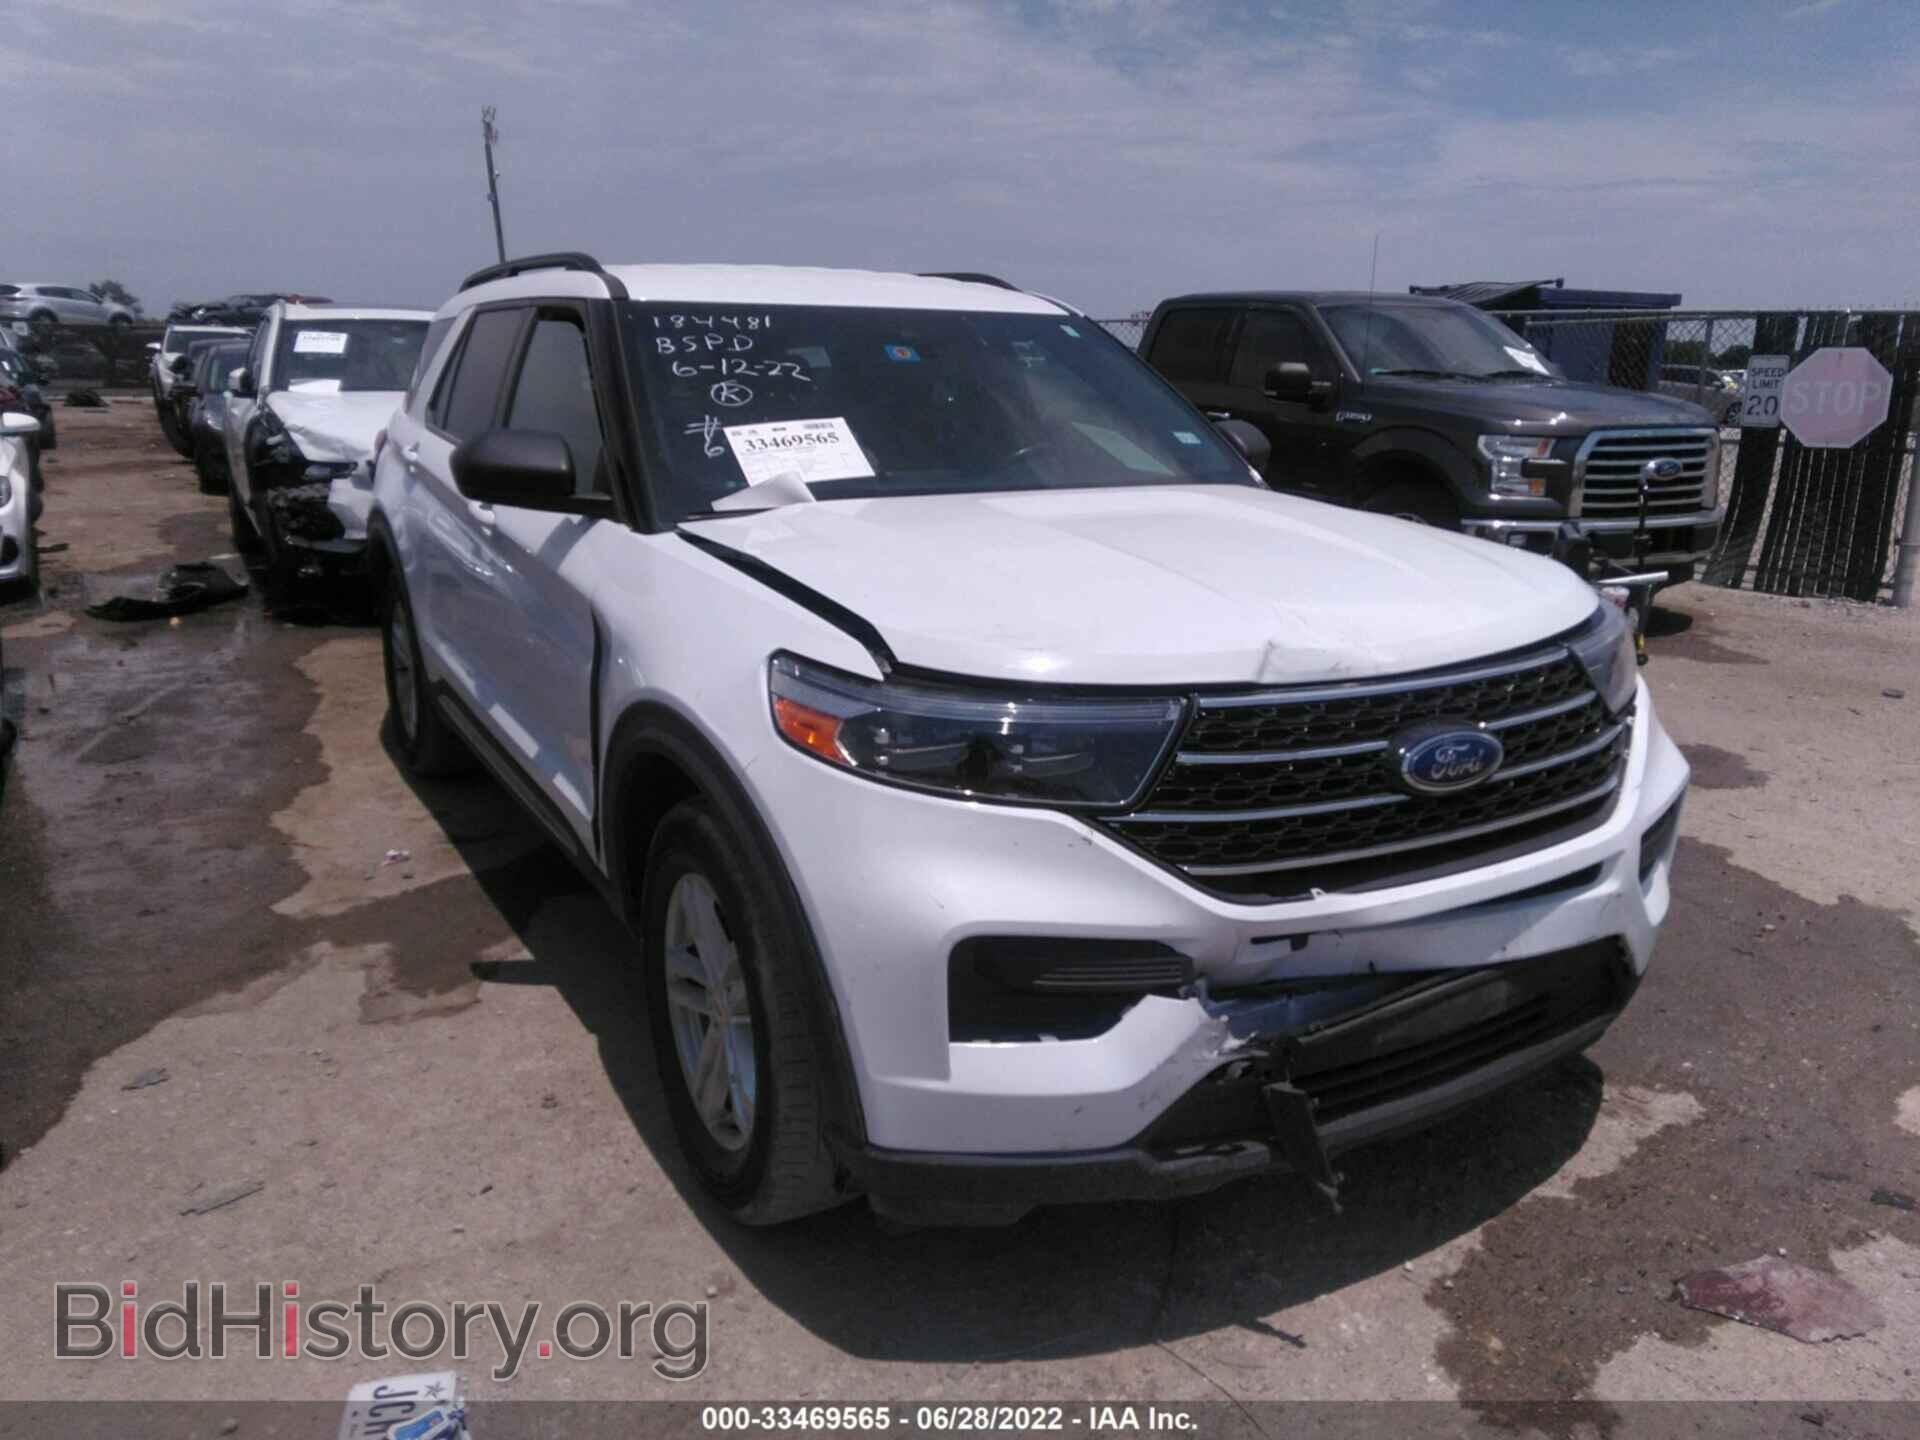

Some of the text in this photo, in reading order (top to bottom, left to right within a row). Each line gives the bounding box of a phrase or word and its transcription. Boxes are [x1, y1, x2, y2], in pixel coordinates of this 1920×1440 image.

[672, 357, 811, 381] 6-12-22
[1751, 367, 1785, 378] SPEED
[1751, 379, 1779, 390] LIMIT
[1746, 395, 1778, 416] 20
[1788, 380, 1881, 417] STOP
[743, 431, 840, 453] 33469565
[1430, 743, 1485, 780] Ford
